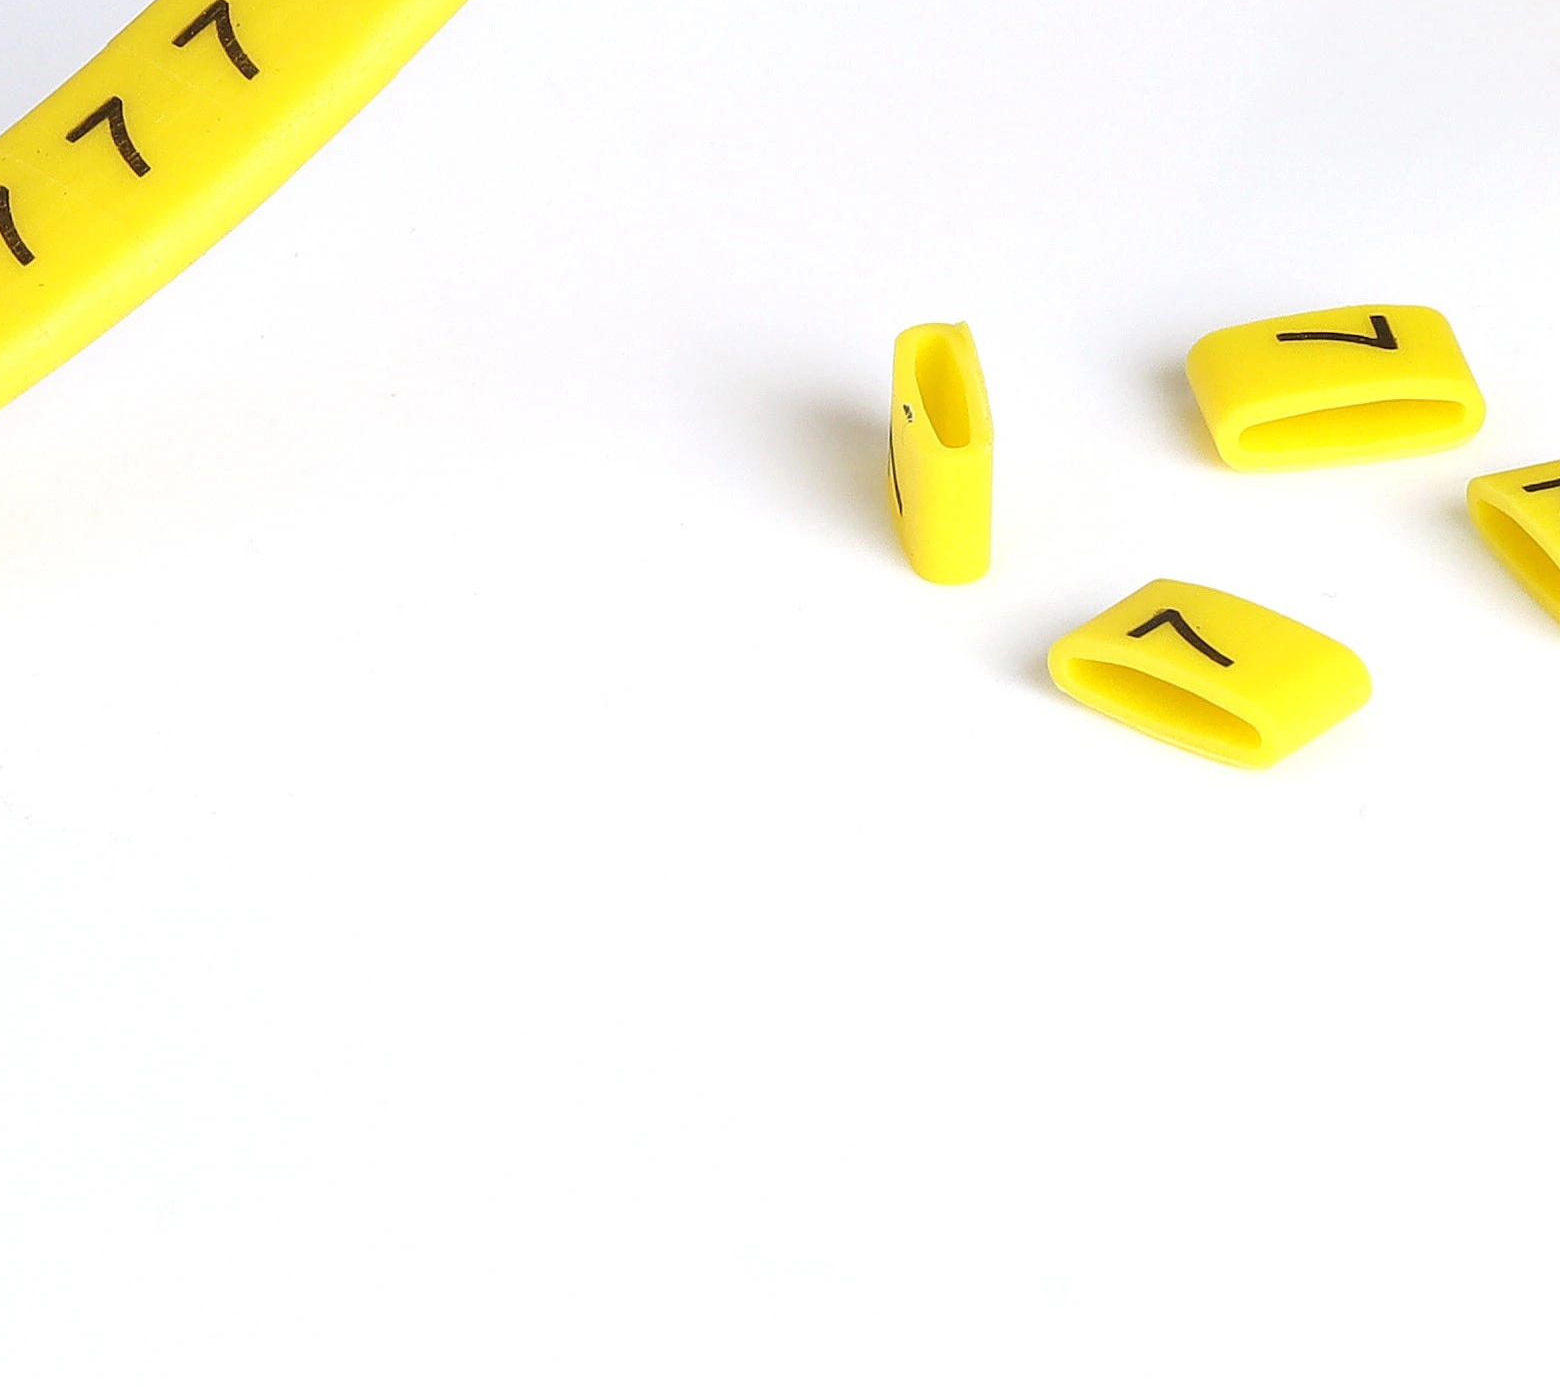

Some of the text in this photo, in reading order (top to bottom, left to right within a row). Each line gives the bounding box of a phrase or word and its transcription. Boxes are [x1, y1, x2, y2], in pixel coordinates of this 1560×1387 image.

[64, 95, 152, 179] 7
[1275, 314, 1400, 352] 7
[1126, 607, 1235, 669] 7
